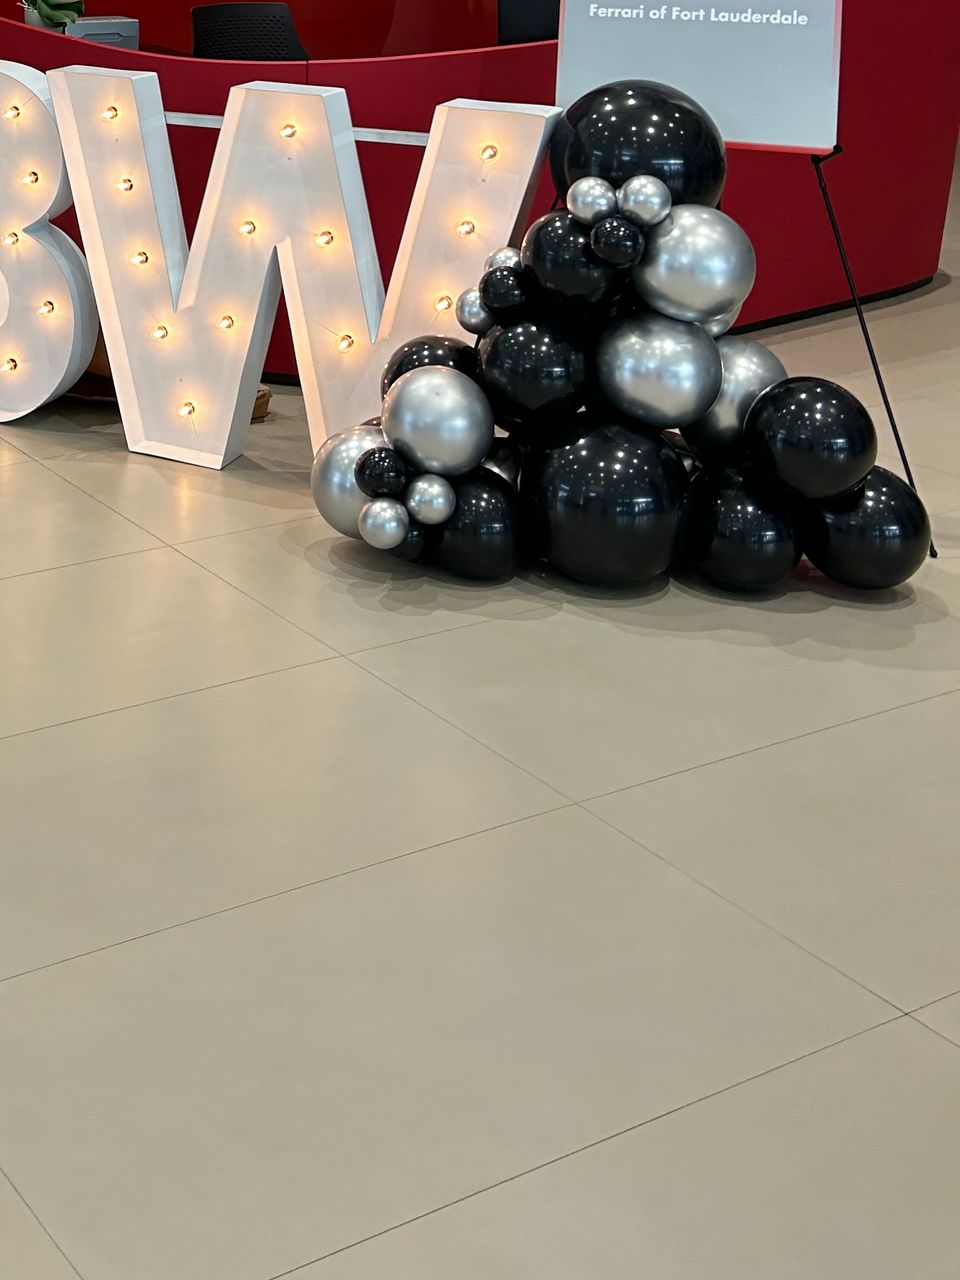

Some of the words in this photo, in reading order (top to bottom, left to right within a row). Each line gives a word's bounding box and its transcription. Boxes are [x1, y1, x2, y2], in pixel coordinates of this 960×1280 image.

[589, 4, 644, 19] Ferrari
[649, 5, 667, 20] of
[672, 6, 705, 21] Fort
[710, 8, 809, 25] Lauderdale
